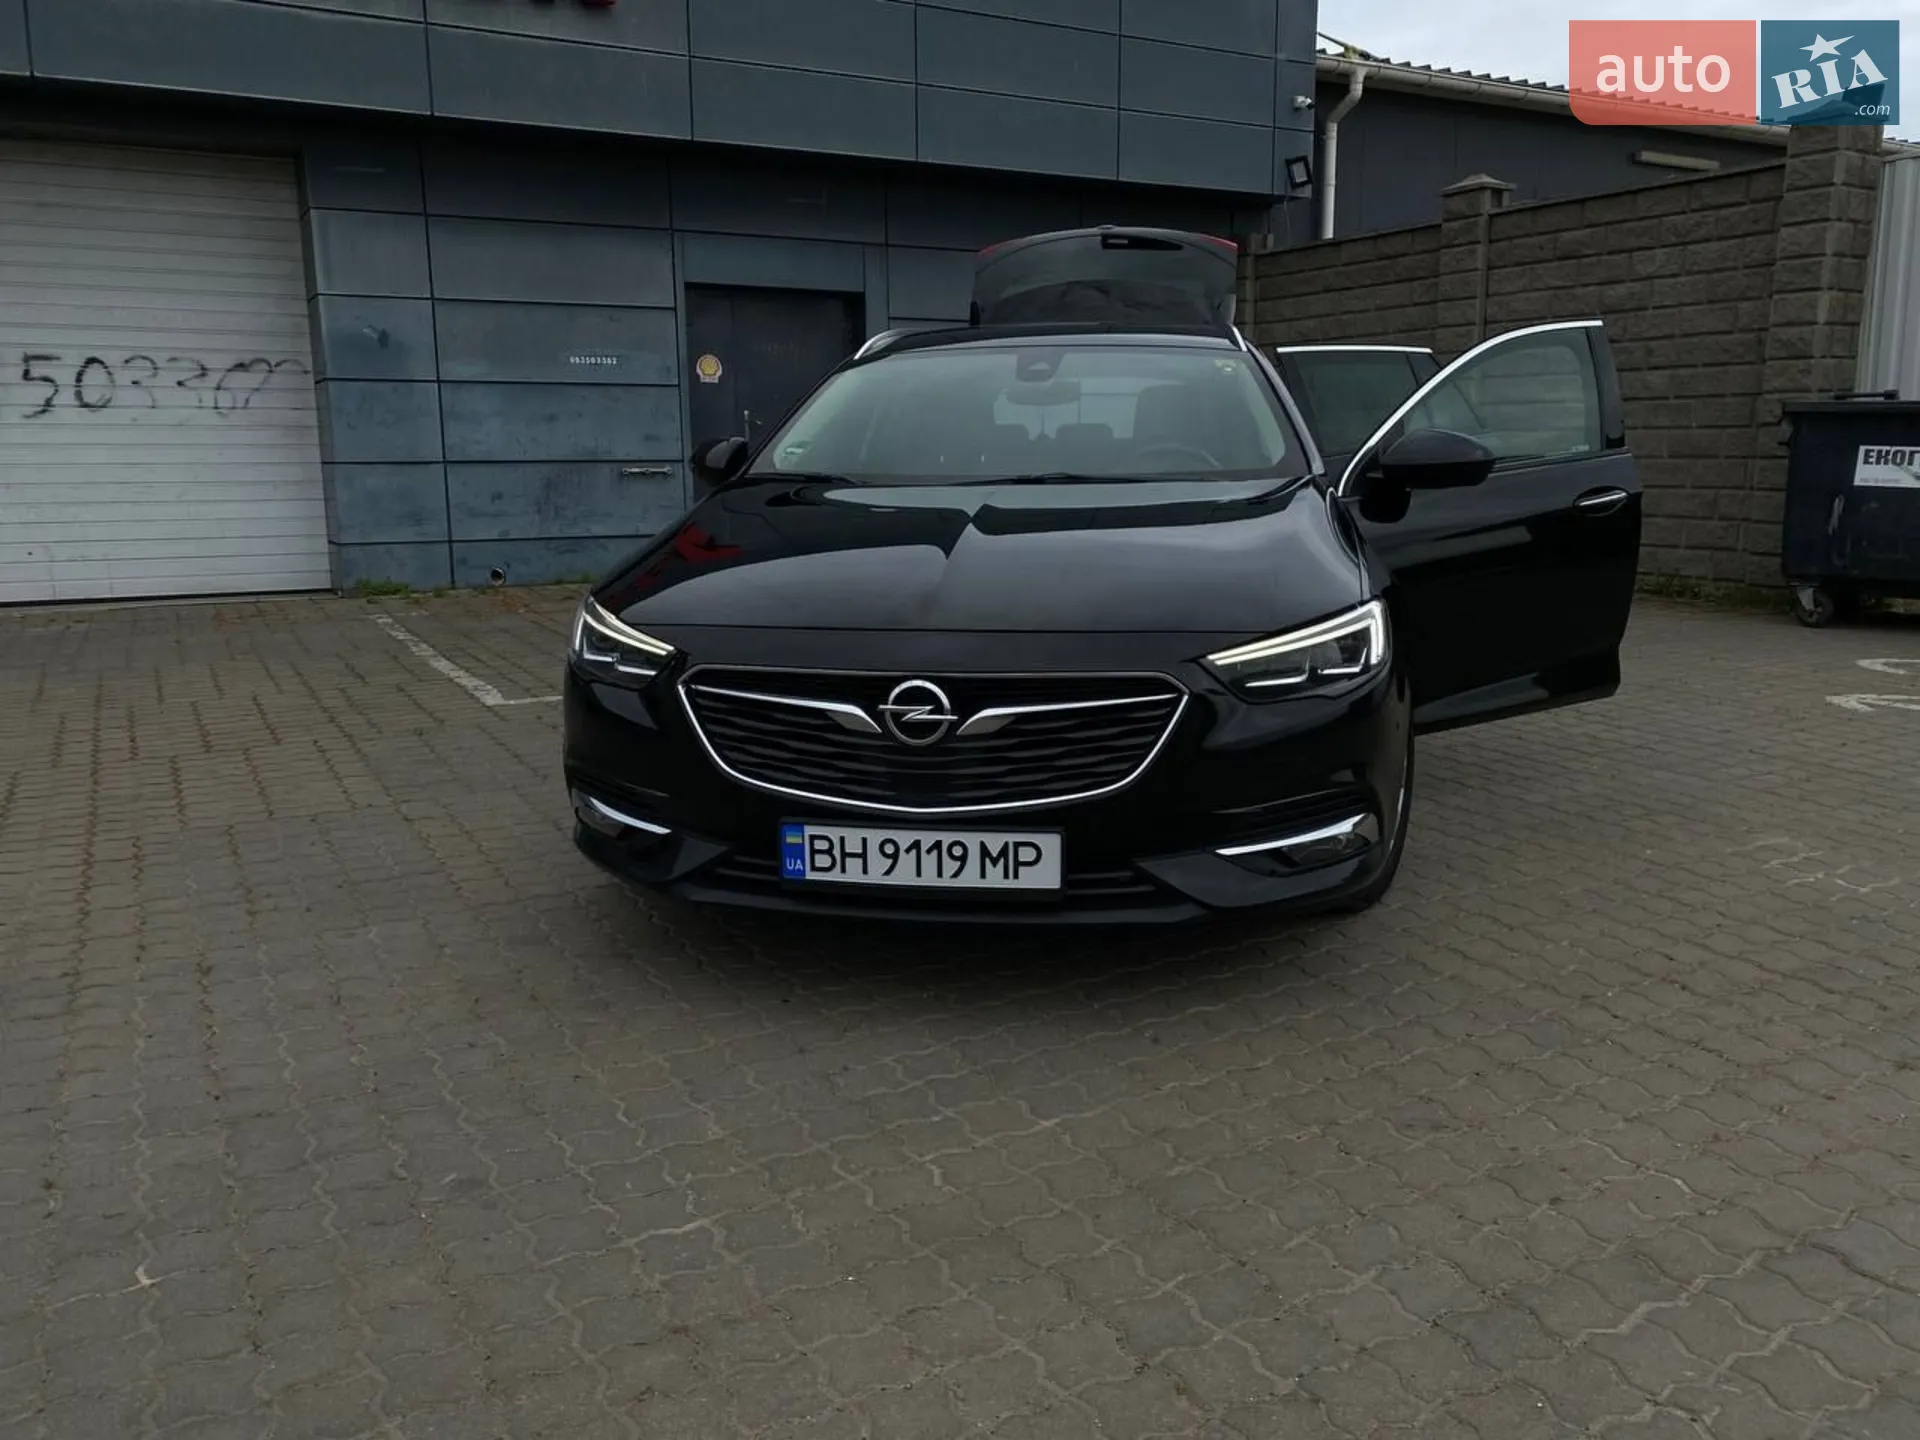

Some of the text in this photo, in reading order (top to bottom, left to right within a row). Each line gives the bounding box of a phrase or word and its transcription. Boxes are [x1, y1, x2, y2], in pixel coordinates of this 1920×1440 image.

[786, 857, 804, 871] UA
[808, 833, 1043, 880] BH 9119 MP
